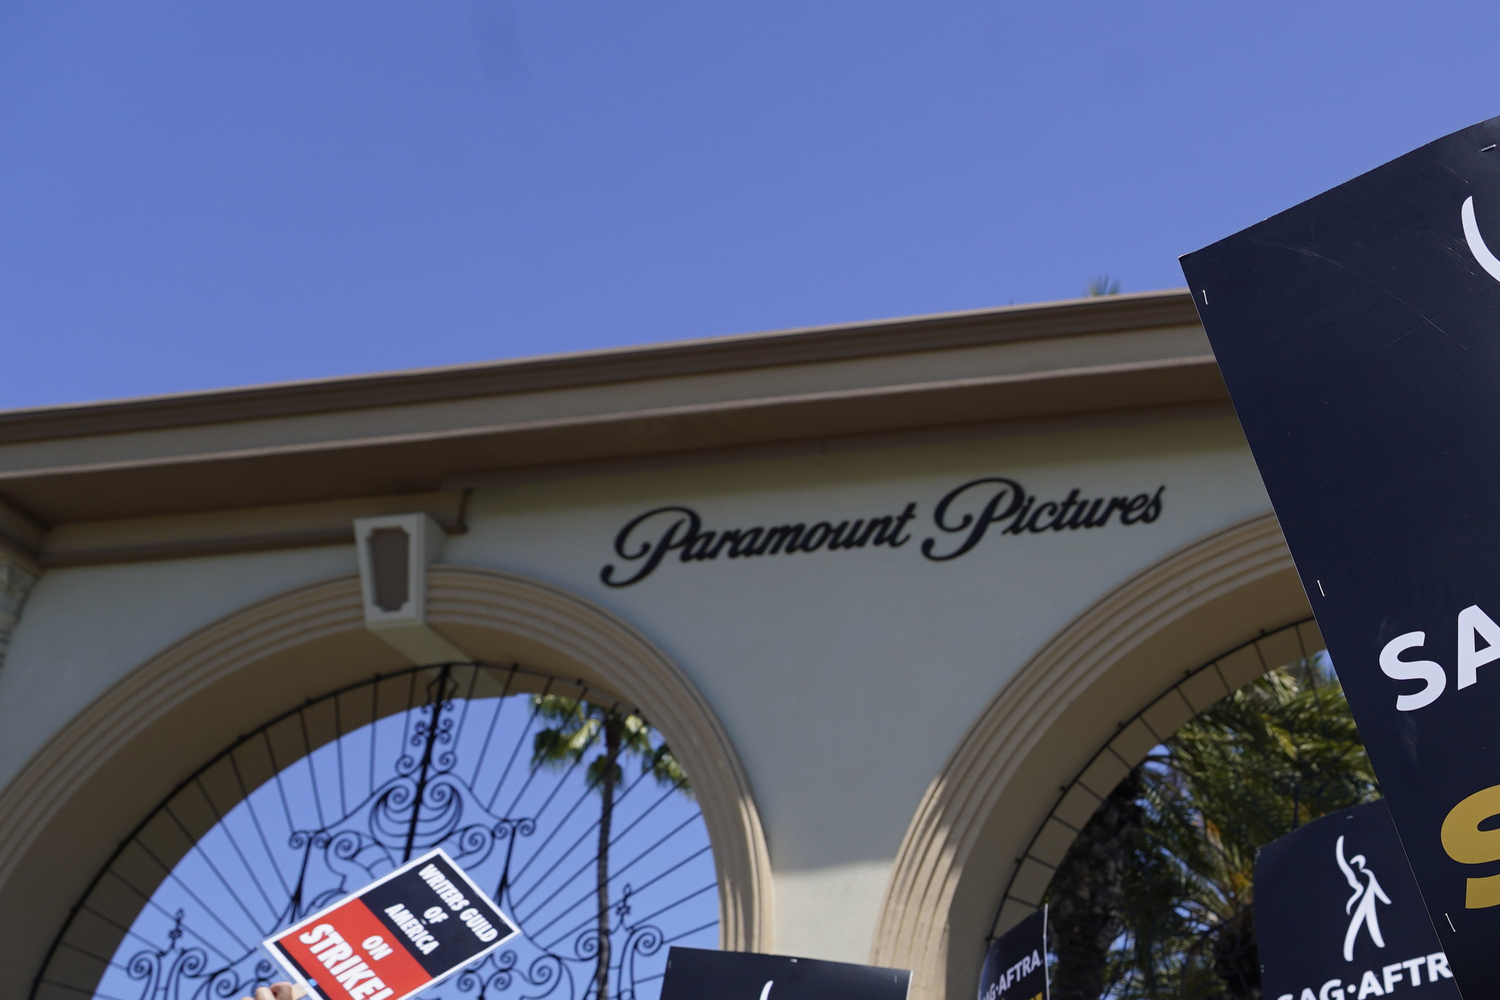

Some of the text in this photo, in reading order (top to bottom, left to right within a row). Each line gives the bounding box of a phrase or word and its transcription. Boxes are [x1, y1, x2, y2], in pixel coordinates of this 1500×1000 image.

[600, 477, 1166, 588] Paramount Pictures
[384, 903, 440, 955] AMERICA
[418, 863, 499, 943] WRITERS GUILD
[423, 906, 450, 925] OF
[361, 935, 393, 961] ON
